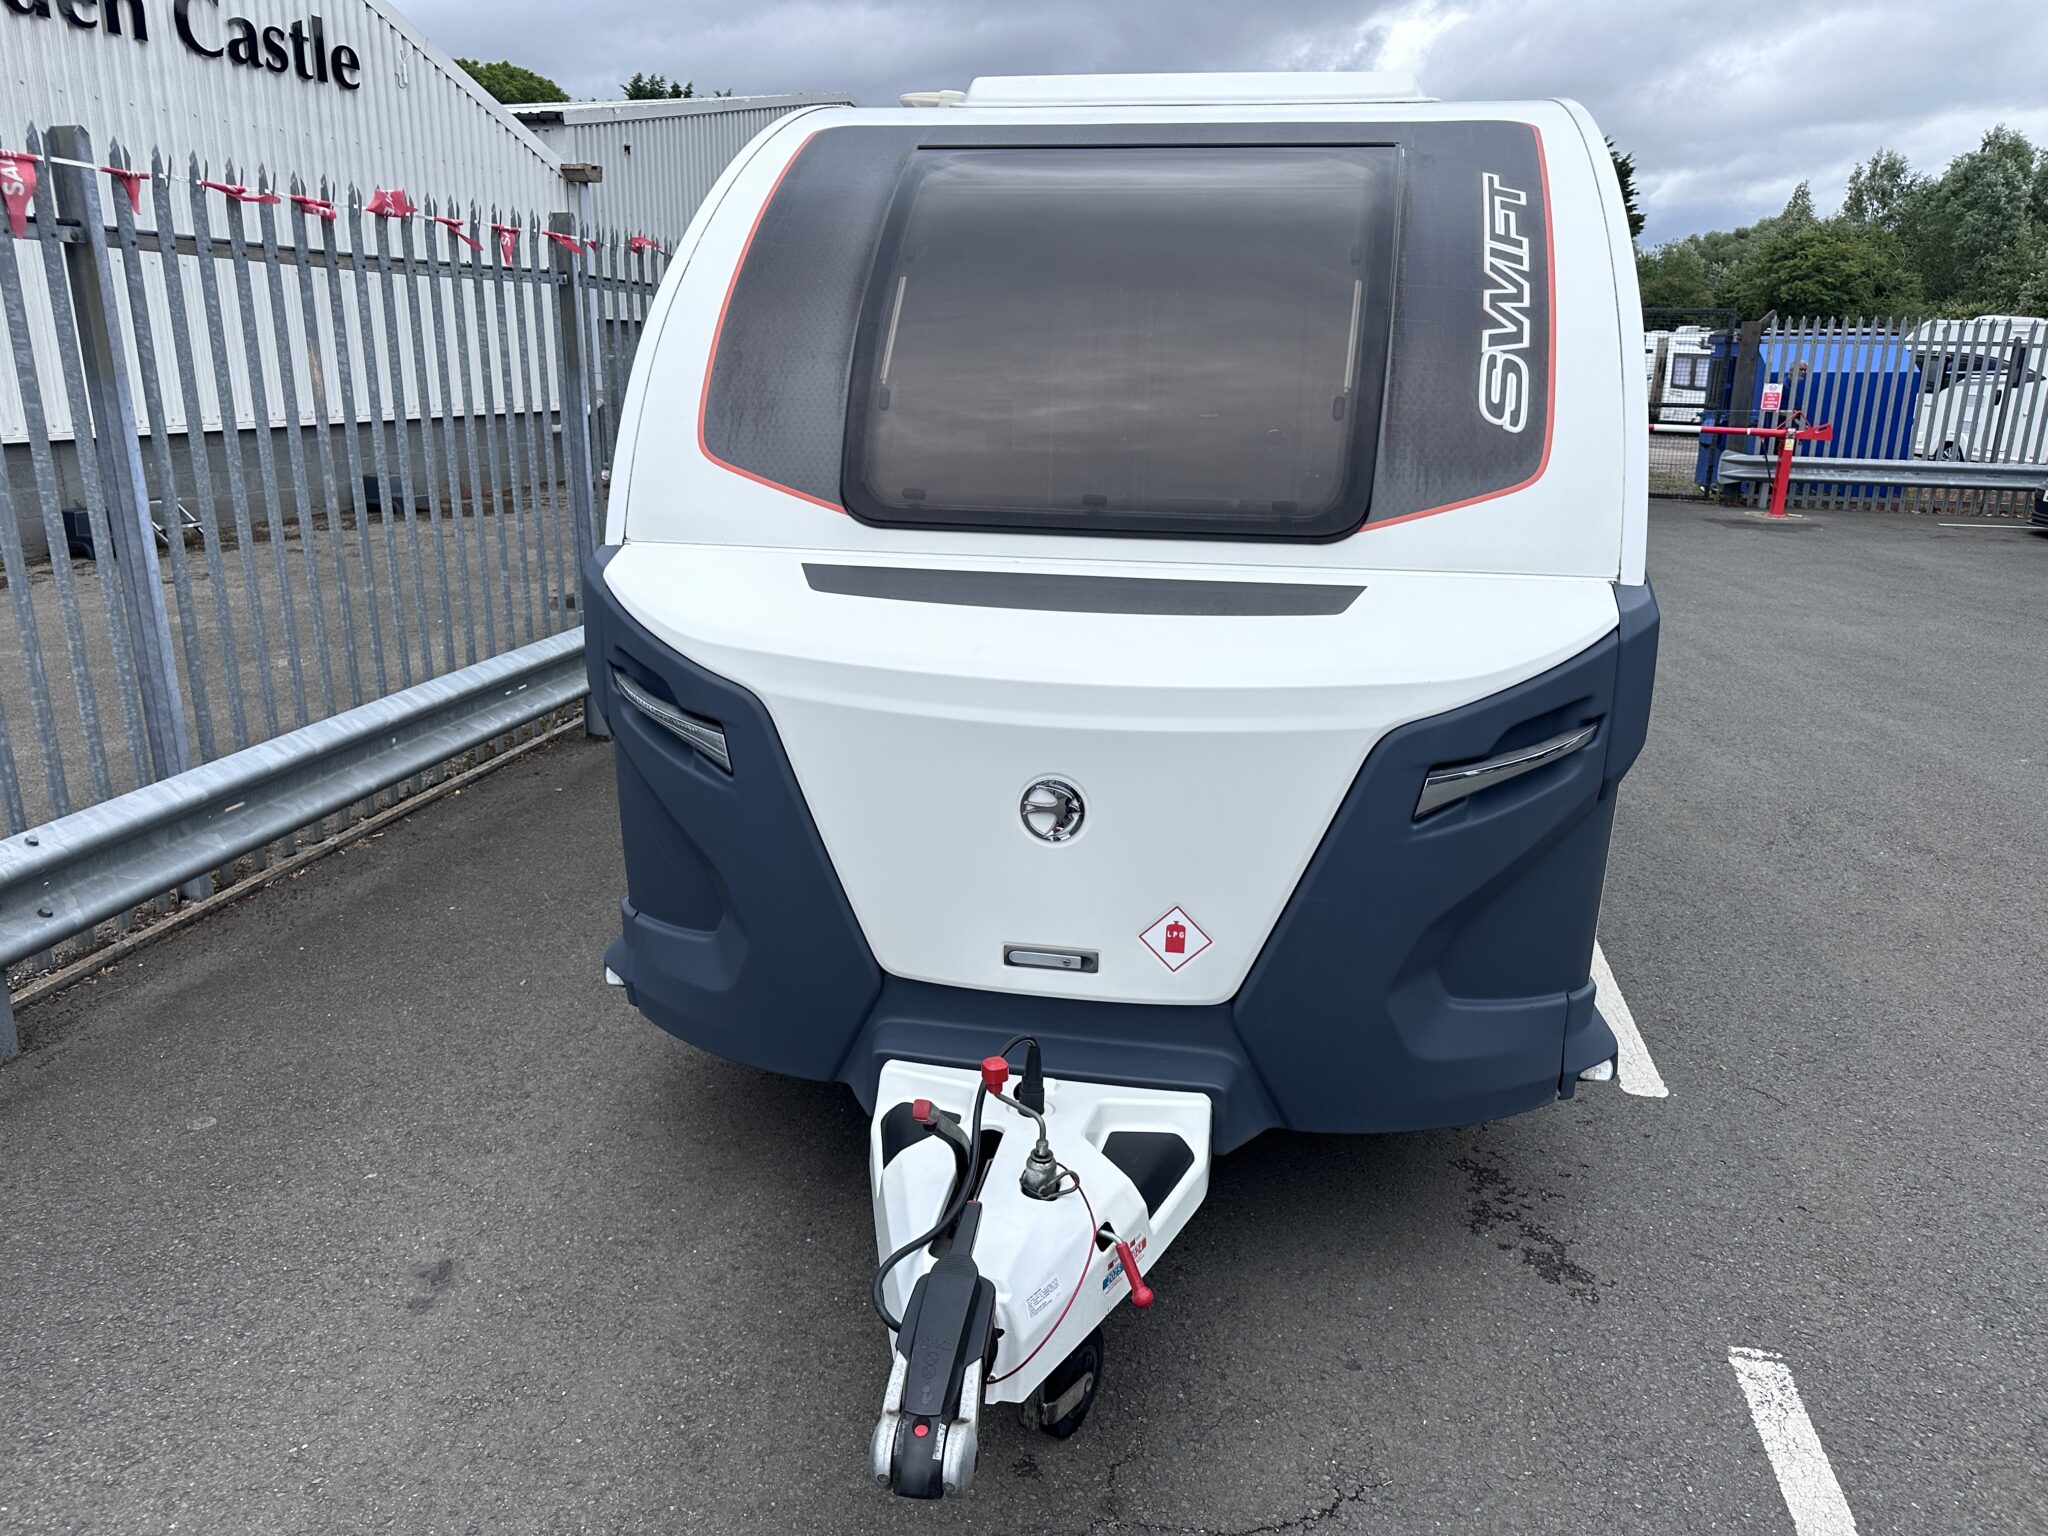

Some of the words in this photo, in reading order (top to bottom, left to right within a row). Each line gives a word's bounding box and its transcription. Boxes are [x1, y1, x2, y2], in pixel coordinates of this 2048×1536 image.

[174, 0, 360, 90] Castle
[1478, 171, 1530, 434] SWIFT
[1167, 930, 1185, 939] LPG
